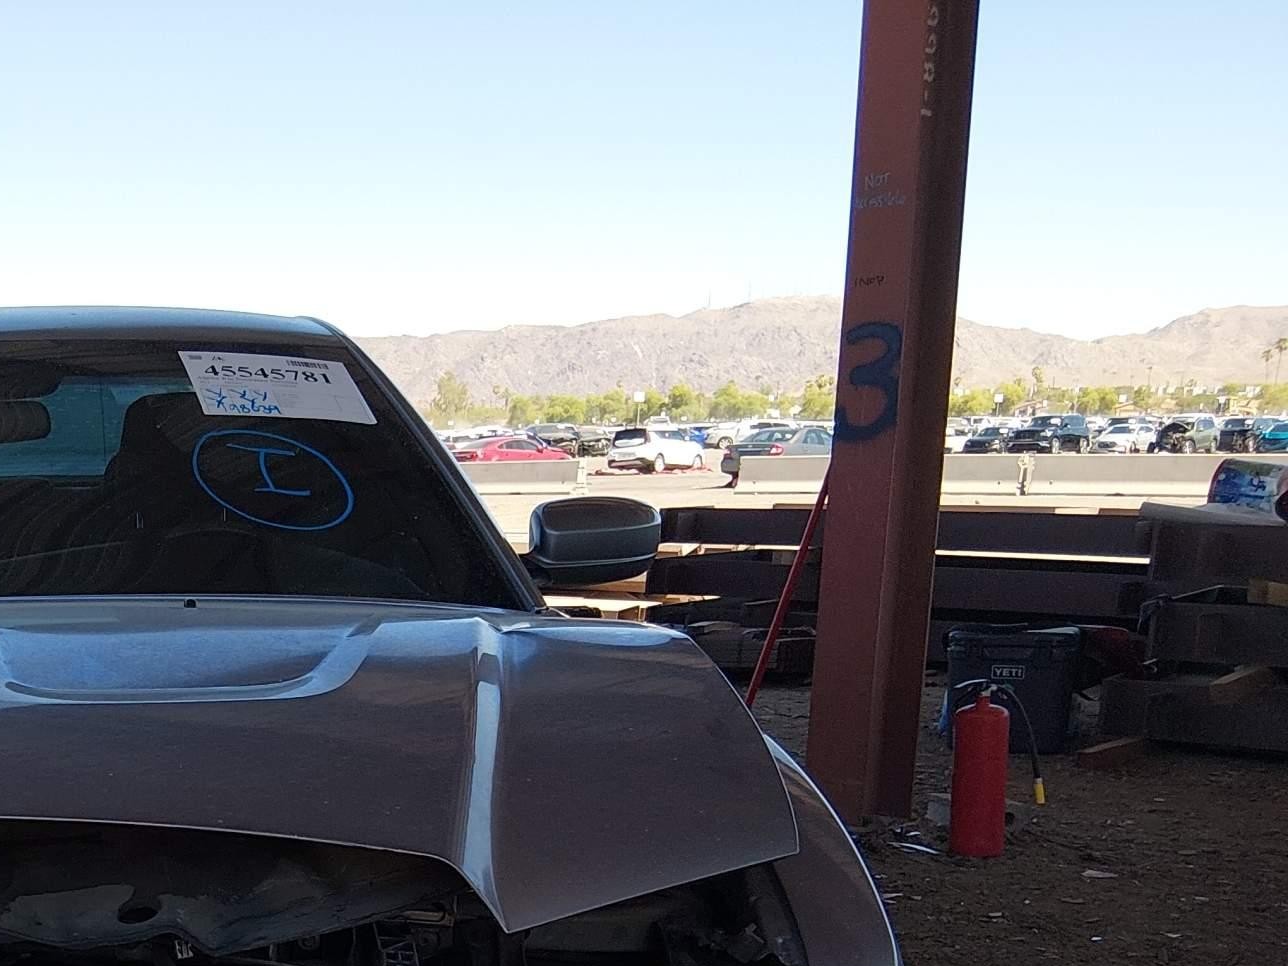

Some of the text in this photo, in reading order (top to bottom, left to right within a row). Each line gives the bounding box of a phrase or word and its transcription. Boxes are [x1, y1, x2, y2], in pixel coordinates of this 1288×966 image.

[204, 364, 332, 385] 45545781
[833, 320, 903, 442] 3
[994, 667, 1023, 677] YETI
